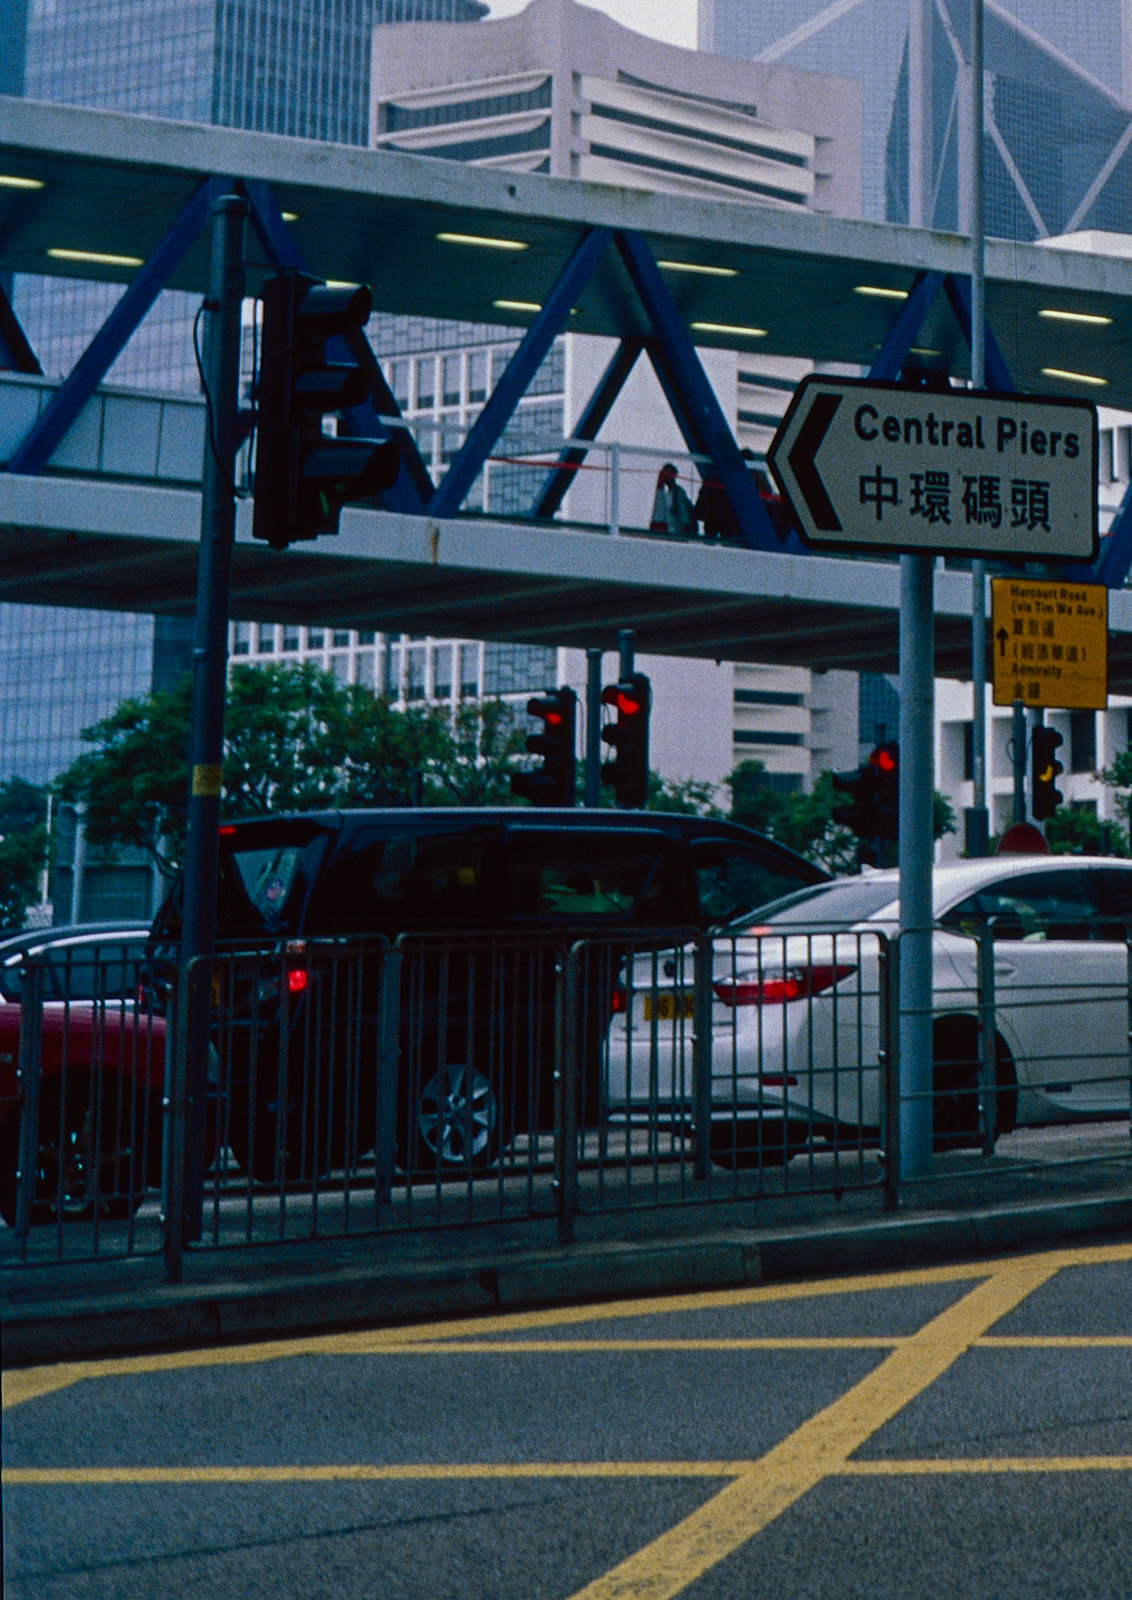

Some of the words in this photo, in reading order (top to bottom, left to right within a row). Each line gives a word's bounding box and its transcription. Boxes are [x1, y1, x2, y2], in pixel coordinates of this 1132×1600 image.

[854, 403, 986, 449] Central
[997, 416, 1080, 458] Piers
[859, 464, 1051, 533] 中環碼頭
[1011, 585, 1058, 600] Harcourt
[1060, 588, 1088, 602] Road
[1035, 601, 1054, 614] Tim
[1012, 662, 1062, 679] Admiralty
